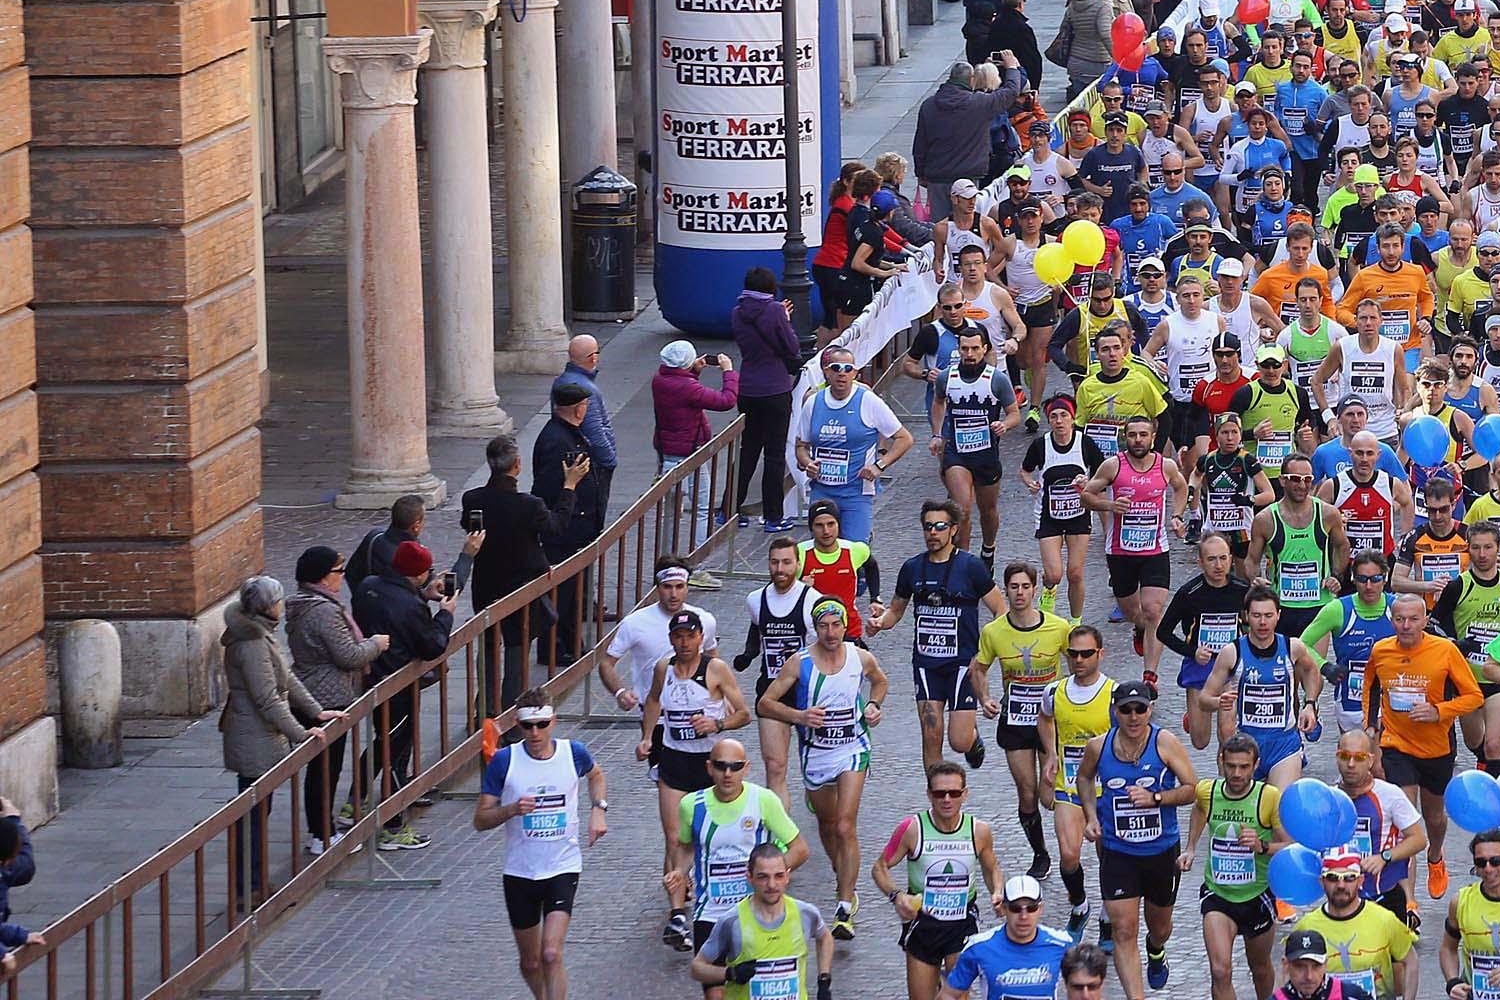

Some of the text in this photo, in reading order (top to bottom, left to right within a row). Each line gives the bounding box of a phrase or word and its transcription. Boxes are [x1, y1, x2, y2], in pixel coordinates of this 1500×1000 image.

[662, 40, 719, 64] Sport
[680, 65, 784, 84] FERRARA
[663, 113, 719, 137] Sport
[680, 138, 786, 158] FERRARA
[663, 187, 719, 211] Sport
[681, 212, 788, 232] FERRARA
[1361, 377, 1375, 386] 147
[1213, 509, 1239, 520] HF225
[1210, 520, 1242, 528] Vassalli
[1121, 541, 1154, 549] Vassalli
[1355, 538, 1372, 548] 340
[1290, 579, 1308, 590] H61
[1282, 590, 1318, 598] Vassalli
[927, 635, 947, 646] 443
[920, 646, 956, 655] Vassalli
[1020, 703, 1037, 715] 291
[1254, 704, 1274, 715] 290
[1245, 715, 1283, 724] Vassalli
[826, 727, 844, 738] 175
[1128, 815, 1146, 829] 511
[526, 829, 566, 838] Vassalli
[1118, 828, 1160, 840] Vassalli
[1218, 860, 1245, 872] H852
[1213, 871, 1253, 881] Vassalli
[926, 906, 965, 916] Vassalli
[759, 982, 790, 996] H644
